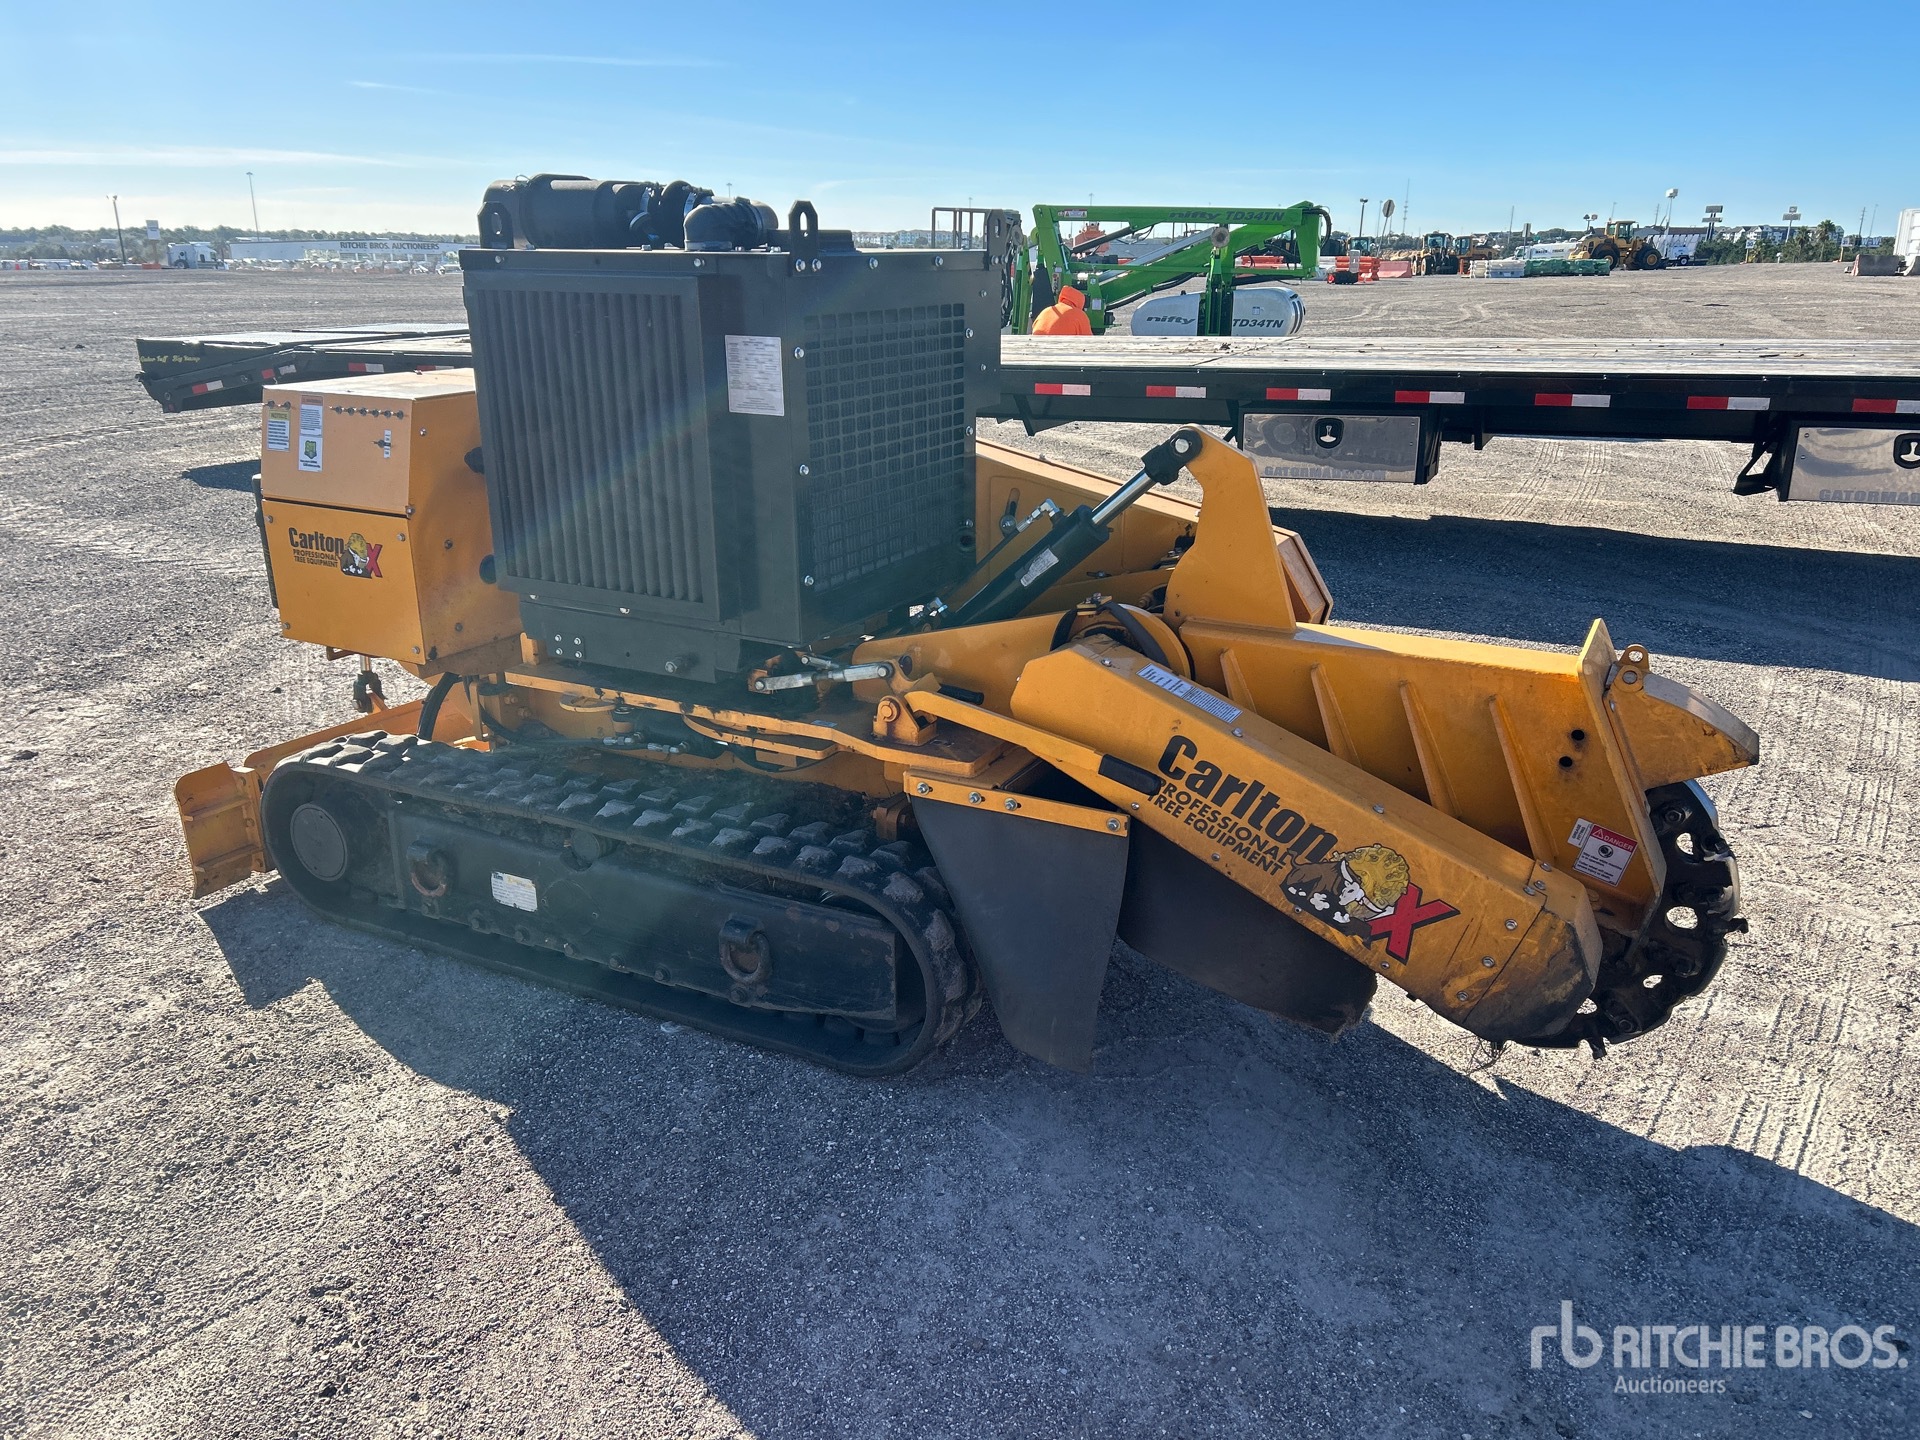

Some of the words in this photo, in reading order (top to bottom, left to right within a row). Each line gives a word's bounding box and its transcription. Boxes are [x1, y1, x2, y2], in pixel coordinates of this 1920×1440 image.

[1169, 211, 1222, 220] nifty
[1225, 211, 1285, 221] TD34TN
[370, 242, 390, 250] BROS.
[392, 242, 440, 250] AUCTIONEERS
[1146, 315, 1197, 325] nifty
[1233, 318, 1285, 328] TD34TN
[288, 527, 345, 555] Carlton
[293, 548, 338, 562] PROFESSIONAL
[294, 555, 306, 564] TREE
[307, 558, 338, 568] EQUIPMENT
[1158, 735, 1339, 864] Carlton
[1148, 795, 1185, 819] REE
[1183, 812, 1284, 876] EQUIPMENT
[1603, 835, 1634, 852] DANGER
